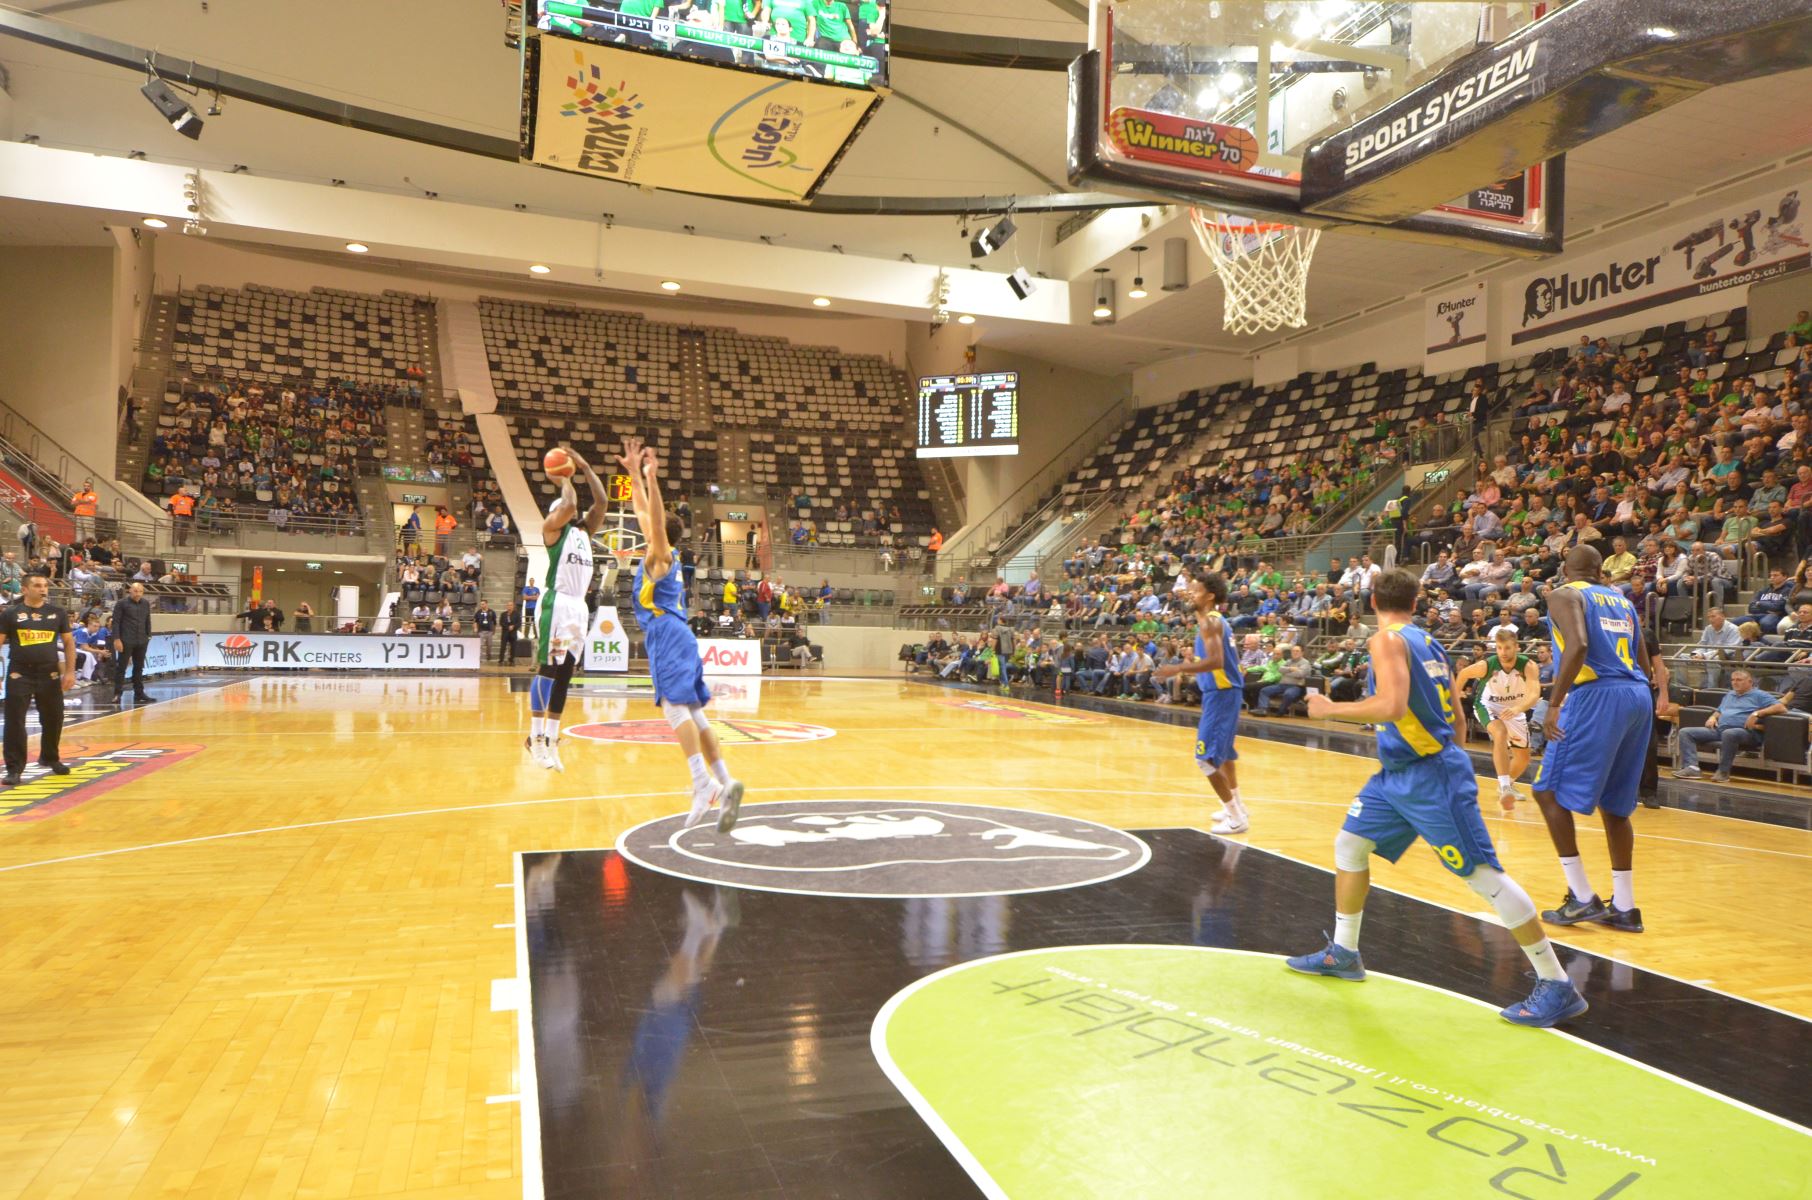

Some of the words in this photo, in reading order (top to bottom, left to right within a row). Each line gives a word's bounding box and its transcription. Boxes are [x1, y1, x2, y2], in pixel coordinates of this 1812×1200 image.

[658, 24, 670, 32] 19
[768, 43, 780, 52] 16
[1345, 106, 1423, 166] SPORT
[1423, 39, 1540, 127] SYSTEM
[1124, 118, 1218, 158] Winner
[1219, 141, 1241, 162] סל
[1184, 127, 1216, 143] ליגת
[1477, 189, 1514, 204] מנהלת
[1480, 198, 1512, 211] הליגה
[1549, 255, 1661, 311] Hunter
[1442, 296, 1476, 313] Hunter
[262, 640, 303, 663] RK
[303, 652, 362, 664] CENTERS
[381, 642, 410, 664] כץ
[418, 643, 465, 664] רענן
[592, 640, 622, 654] RK
[1615, 637, 1634, 671] 4
[1388, 1075, 1657, 1167] www.rozenblatt.co.il
